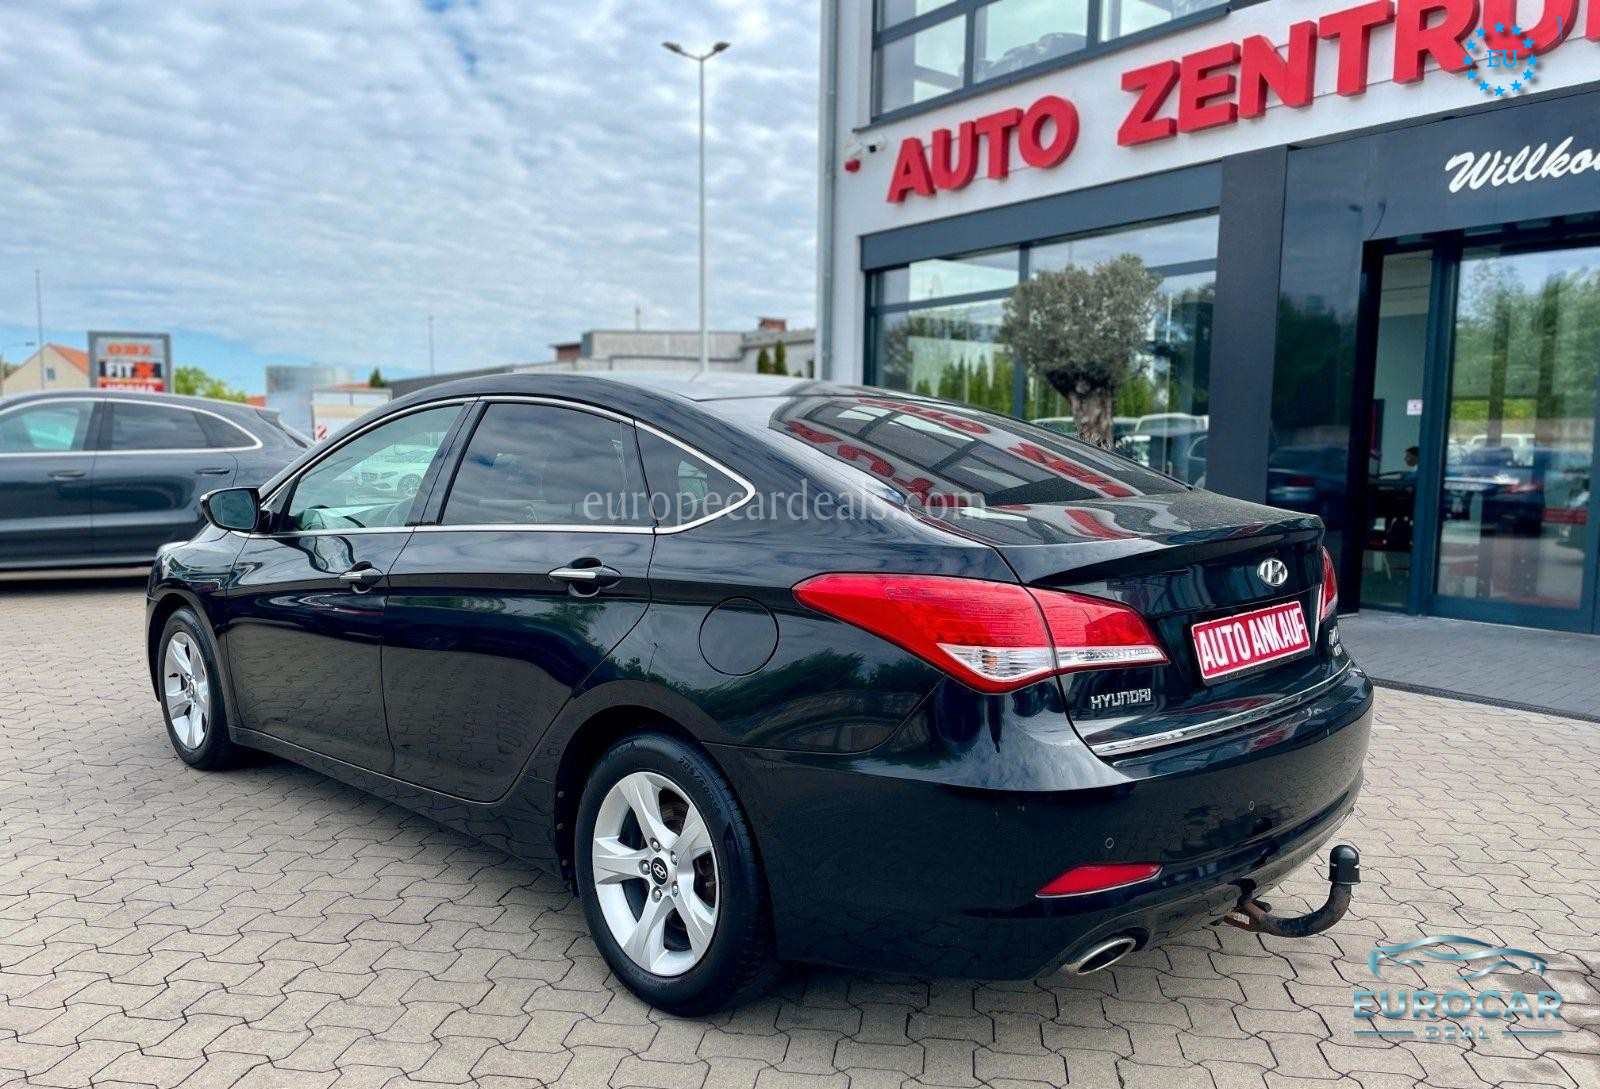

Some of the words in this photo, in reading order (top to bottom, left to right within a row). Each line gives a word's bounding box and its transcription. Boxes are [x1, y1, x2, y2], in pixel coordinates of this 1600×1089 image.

[885, 94, 1080, 204] AUTO
[1117, 0, 1600, 147] ZENTRU
[1445, 135, 1600, 194] Willko
[1198, 620, 1252, 672] AUTO
[1247, 606, 1306, 657] ANKAUF
[1090, 687, 1152, 710] HYUNDAI
